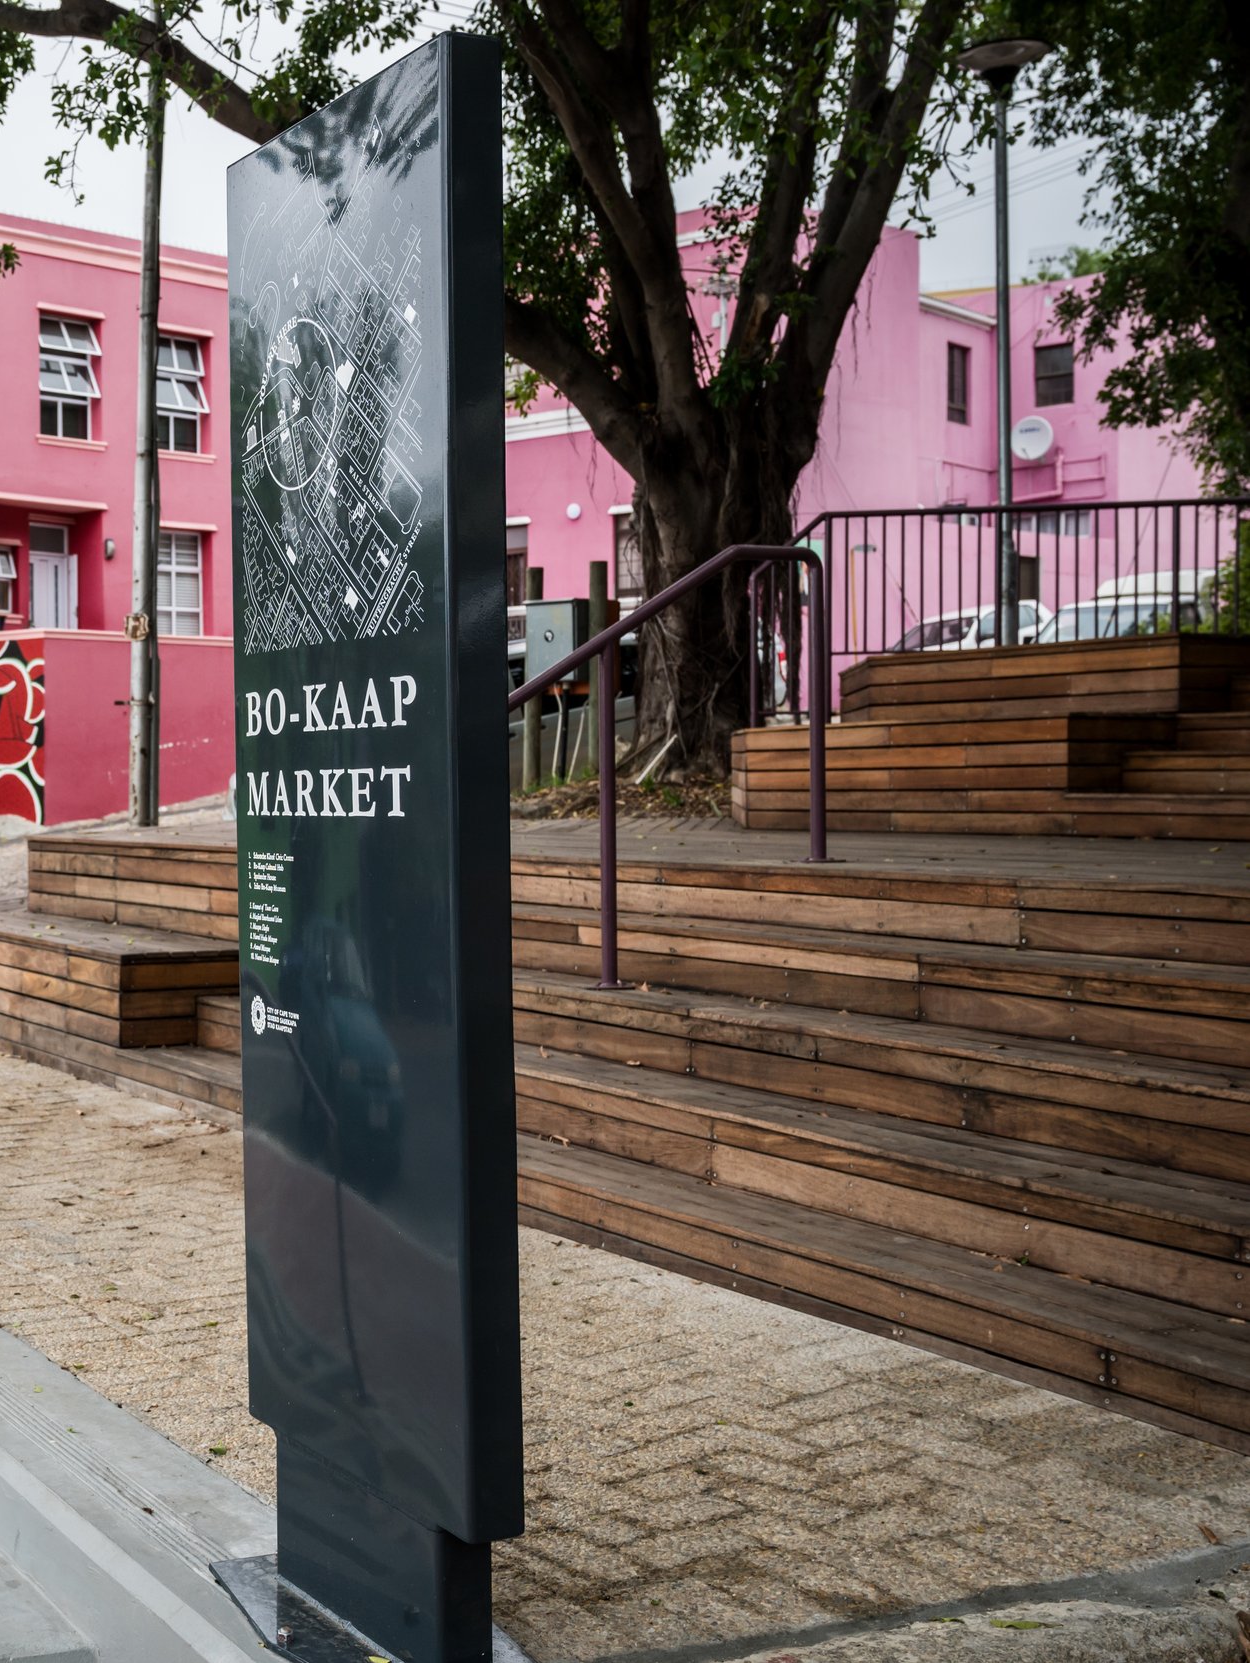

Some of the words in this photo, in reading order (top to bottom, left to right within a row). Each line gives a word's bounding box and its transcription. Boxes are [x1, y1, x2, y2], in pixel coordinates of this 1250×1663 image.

[258, 372, 267, 407] YOU
[266, 342, 277, 366] ARE
[276, 316, 298, 344] HERE
[349, 464, 363, 488] WALE
[362, 485, 383, 513] STREET
[366, 560, 404, 636] BUITENGRACHT
[402, 520, 423, 559] STREET
[245, 674, 417, 736] BO-KAAP
[246, 764, 410, 817] MARKET
[279, 1009, 288, 1018] CAPE
[288, 1012, 299, 1020] TOWN
